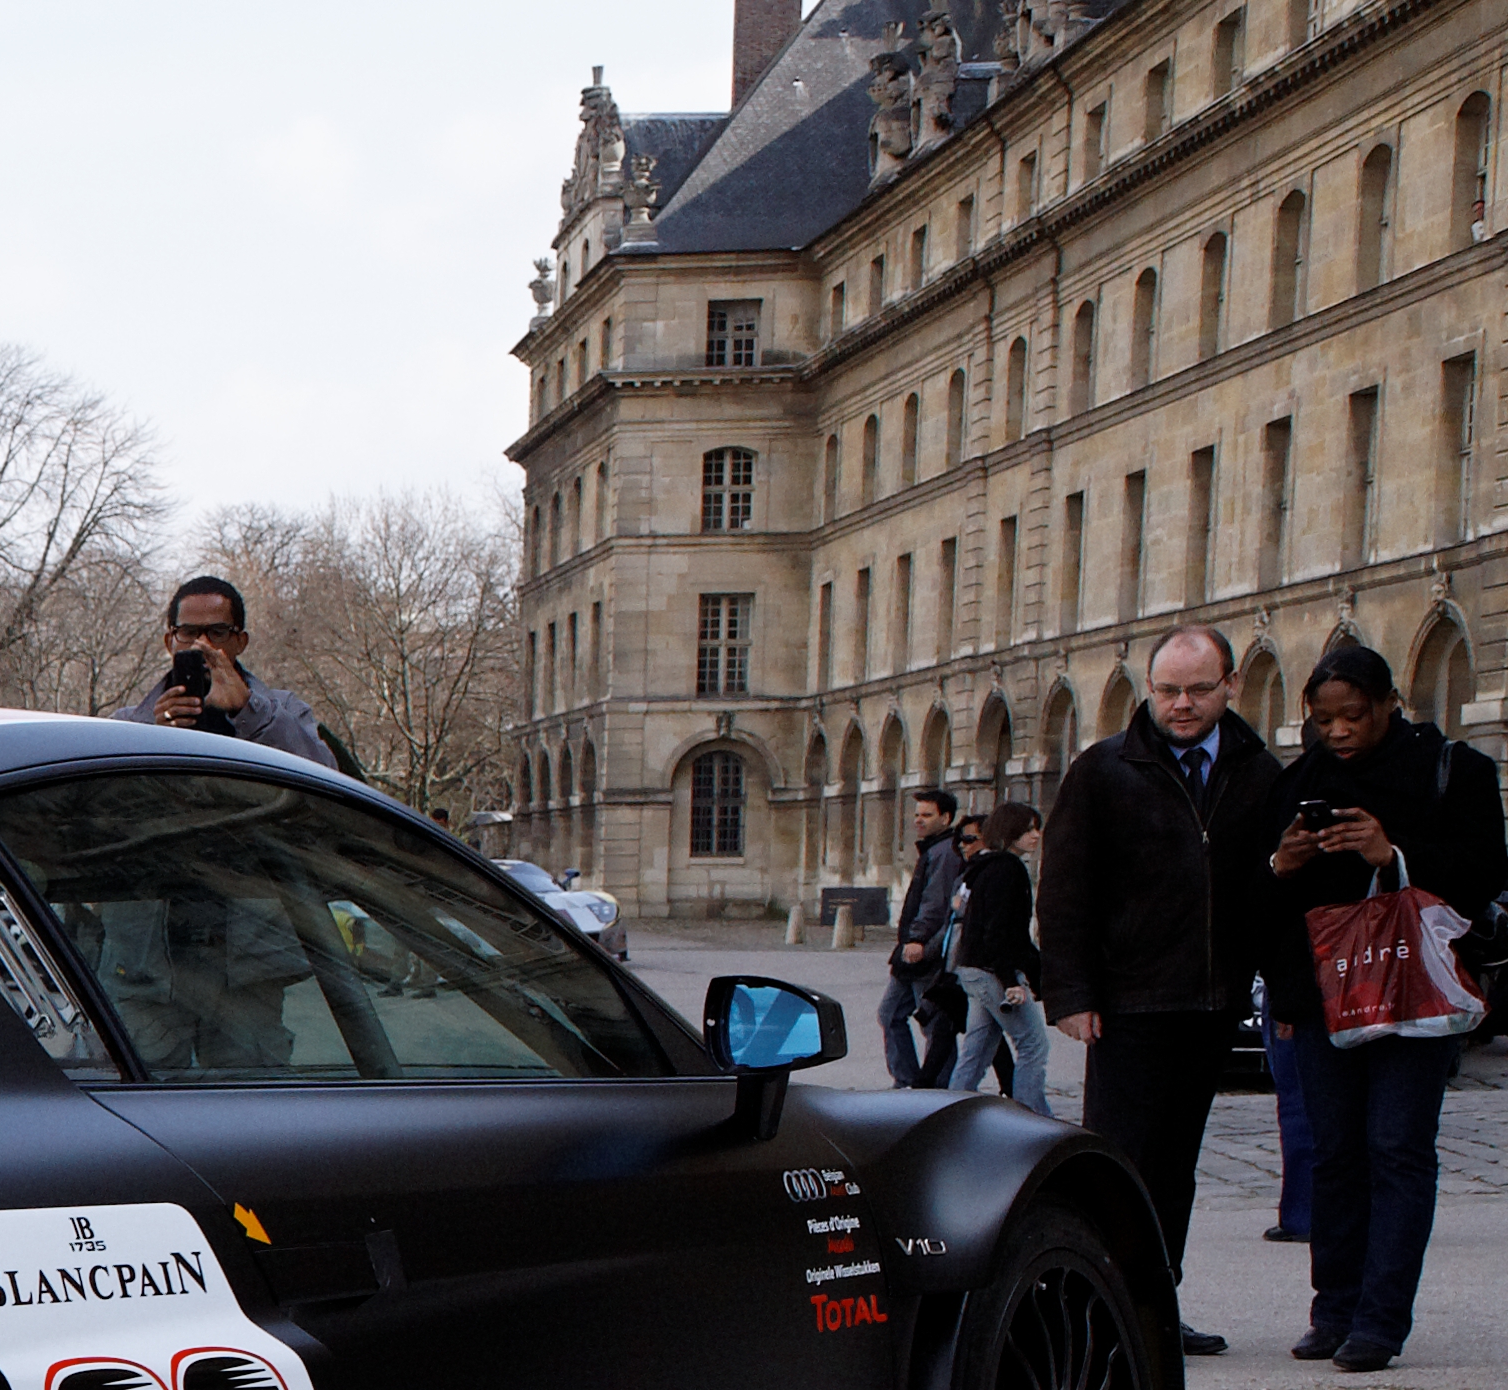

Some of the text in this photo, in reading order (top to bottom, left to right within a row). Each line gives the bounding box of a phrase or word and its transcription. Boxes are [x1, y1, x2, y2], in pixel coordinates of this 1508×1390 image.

[69, 1240, 106, 1252] 1735
[895, 1237, 947, 1255] V10
[810, 1293, 888, 1332] TOTAL
